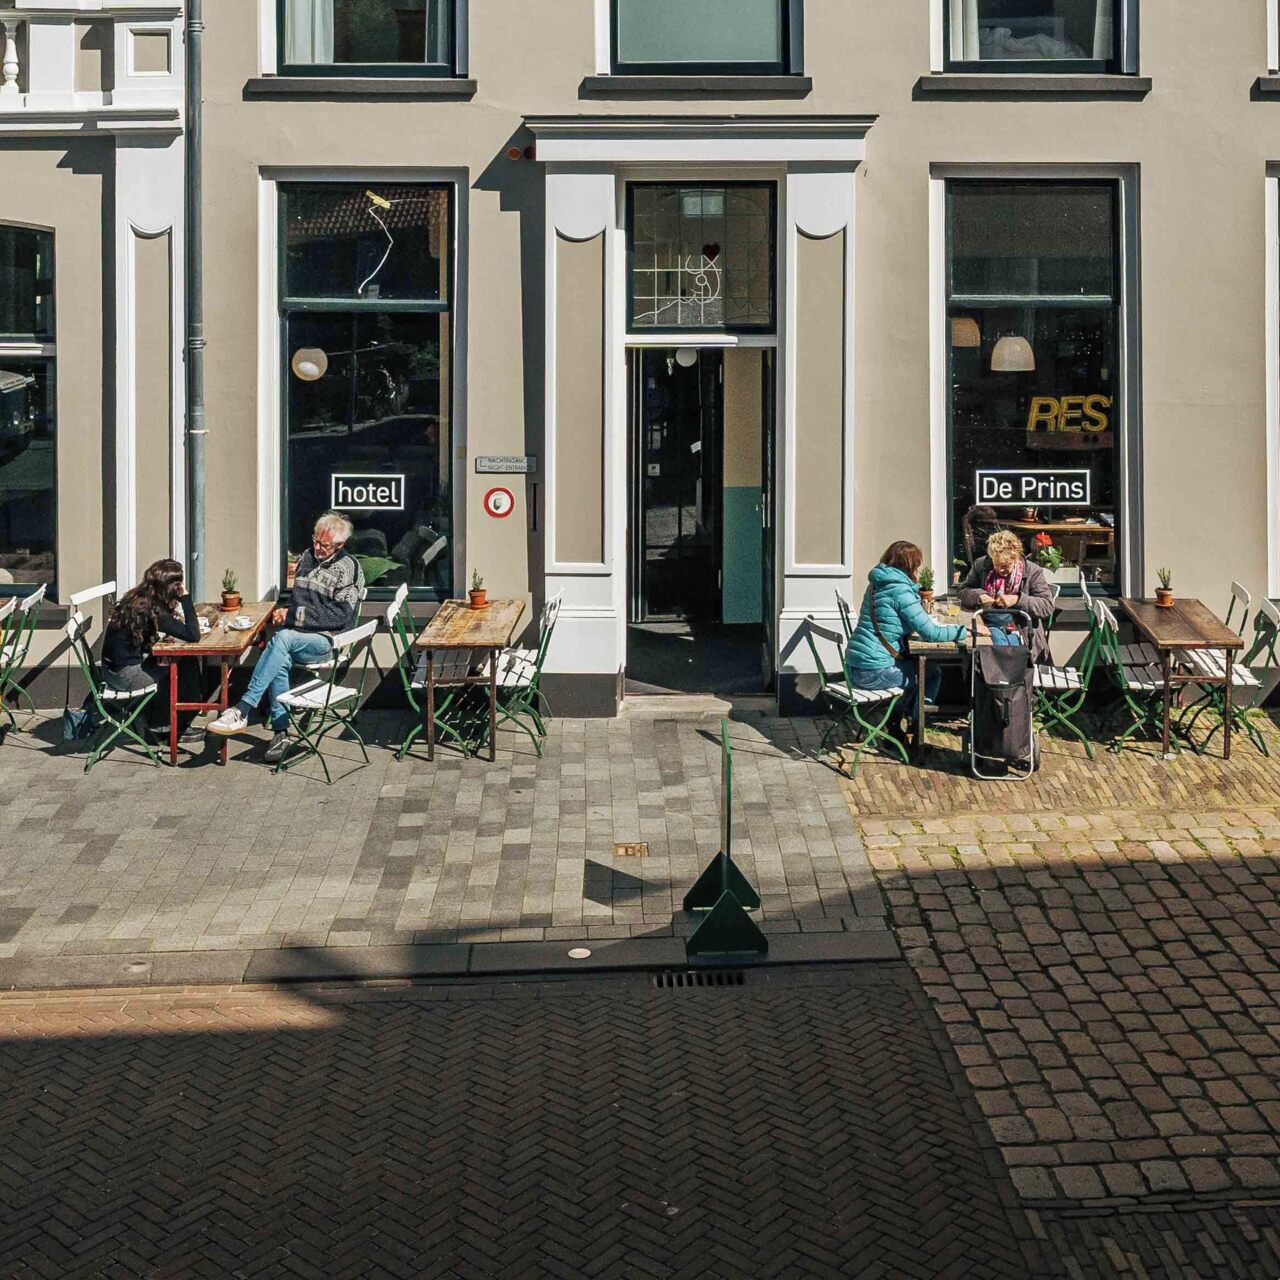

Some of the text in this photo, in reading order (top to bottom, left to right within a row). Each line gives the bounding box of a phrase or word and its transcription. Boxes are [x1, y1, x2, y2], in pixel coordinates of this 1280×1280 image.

[1027, 394, 1113, 433] RES
[338, 481, 398, 504] hotel
[982, 476, 1084, 499] De Prins
